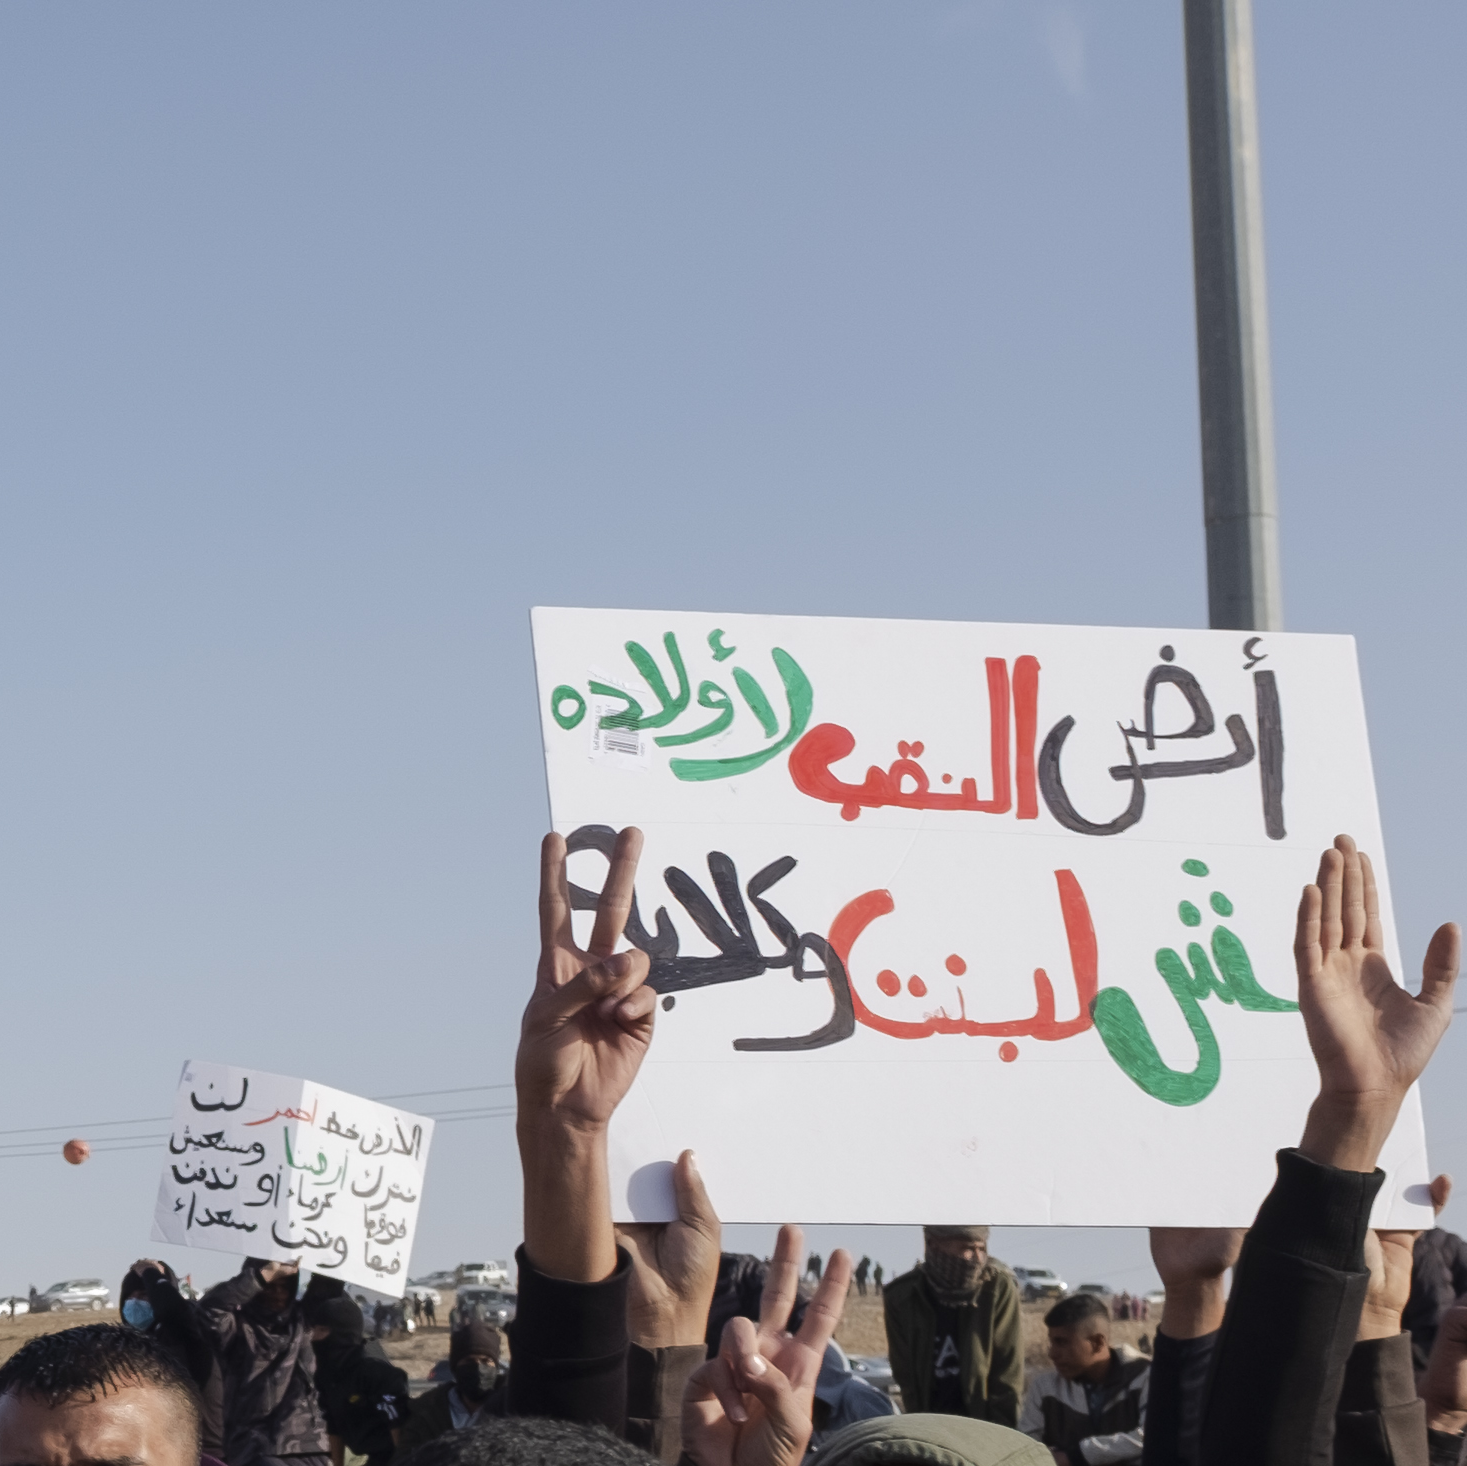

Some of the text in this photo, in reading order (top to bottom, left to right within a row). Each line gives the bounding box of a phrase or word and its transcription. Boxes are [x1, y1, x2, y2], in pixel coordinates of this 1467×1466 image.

[788, 655, 1041, 822] النقب
[1038, 636, 1286, 840] أرض
[190, 1077, 249, 1112] لن
